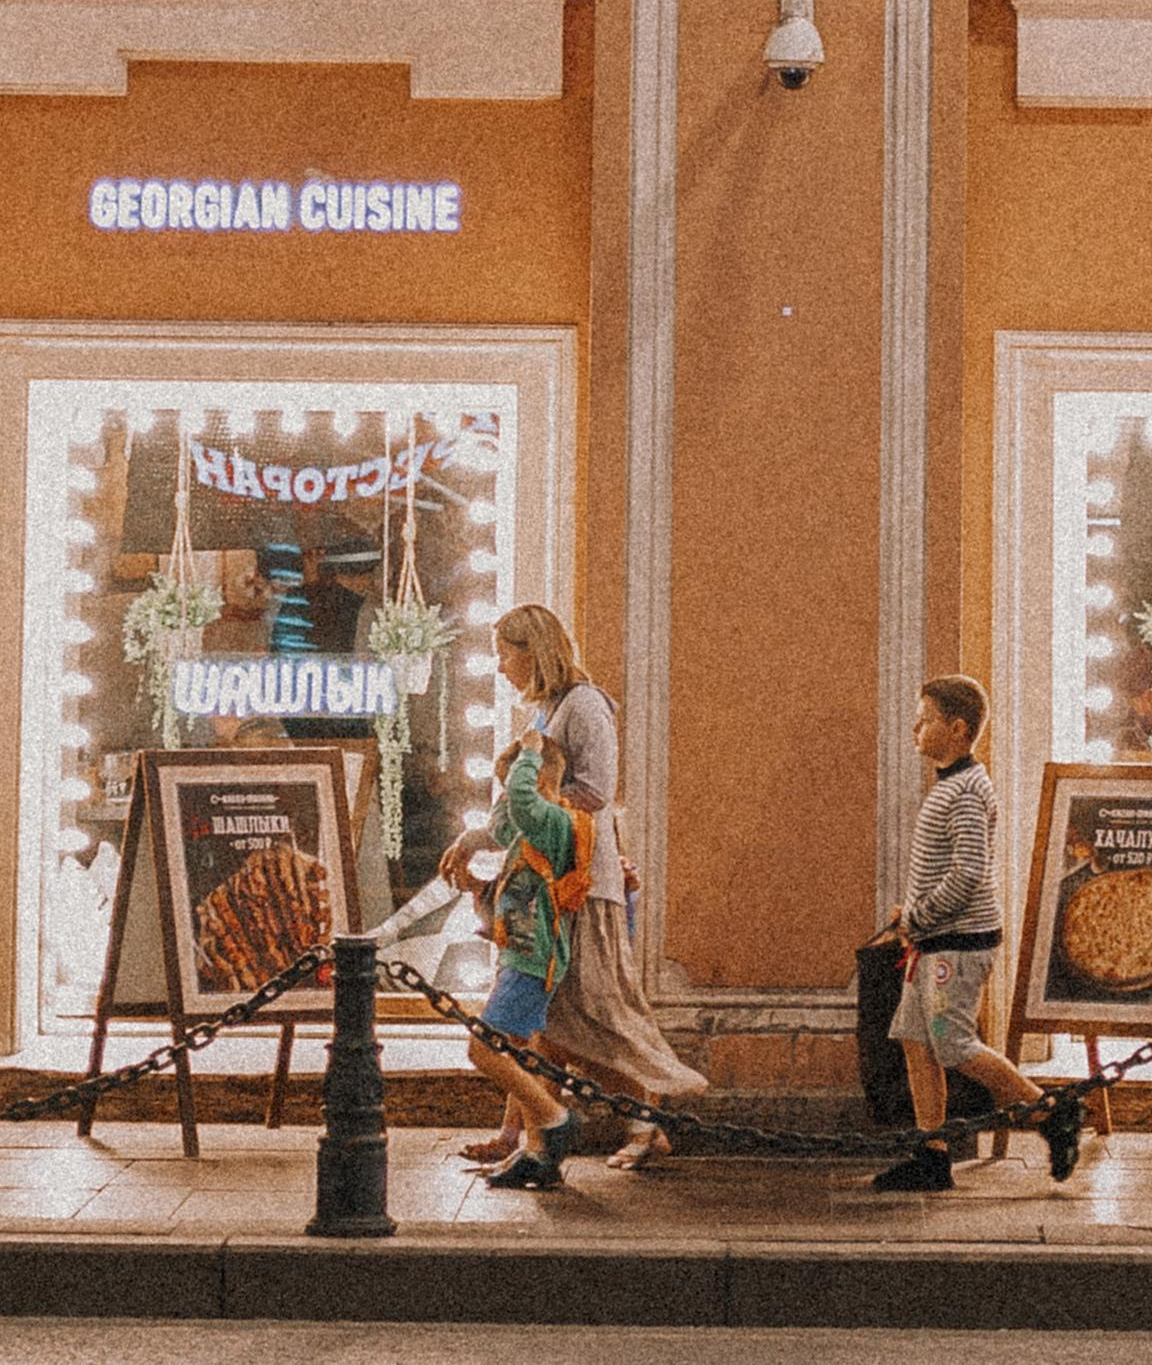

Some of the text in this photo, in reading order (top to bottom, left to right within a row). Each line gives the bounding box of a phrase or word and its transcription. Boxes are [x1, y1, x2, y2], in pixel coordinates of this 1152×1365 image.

[90, 180, 460, 232] GEORGIAN CUISINE
[174, 660, 394, 716] ШАШЛЫК
[211, 815, 290, 834] ШАШЛЫКИ
